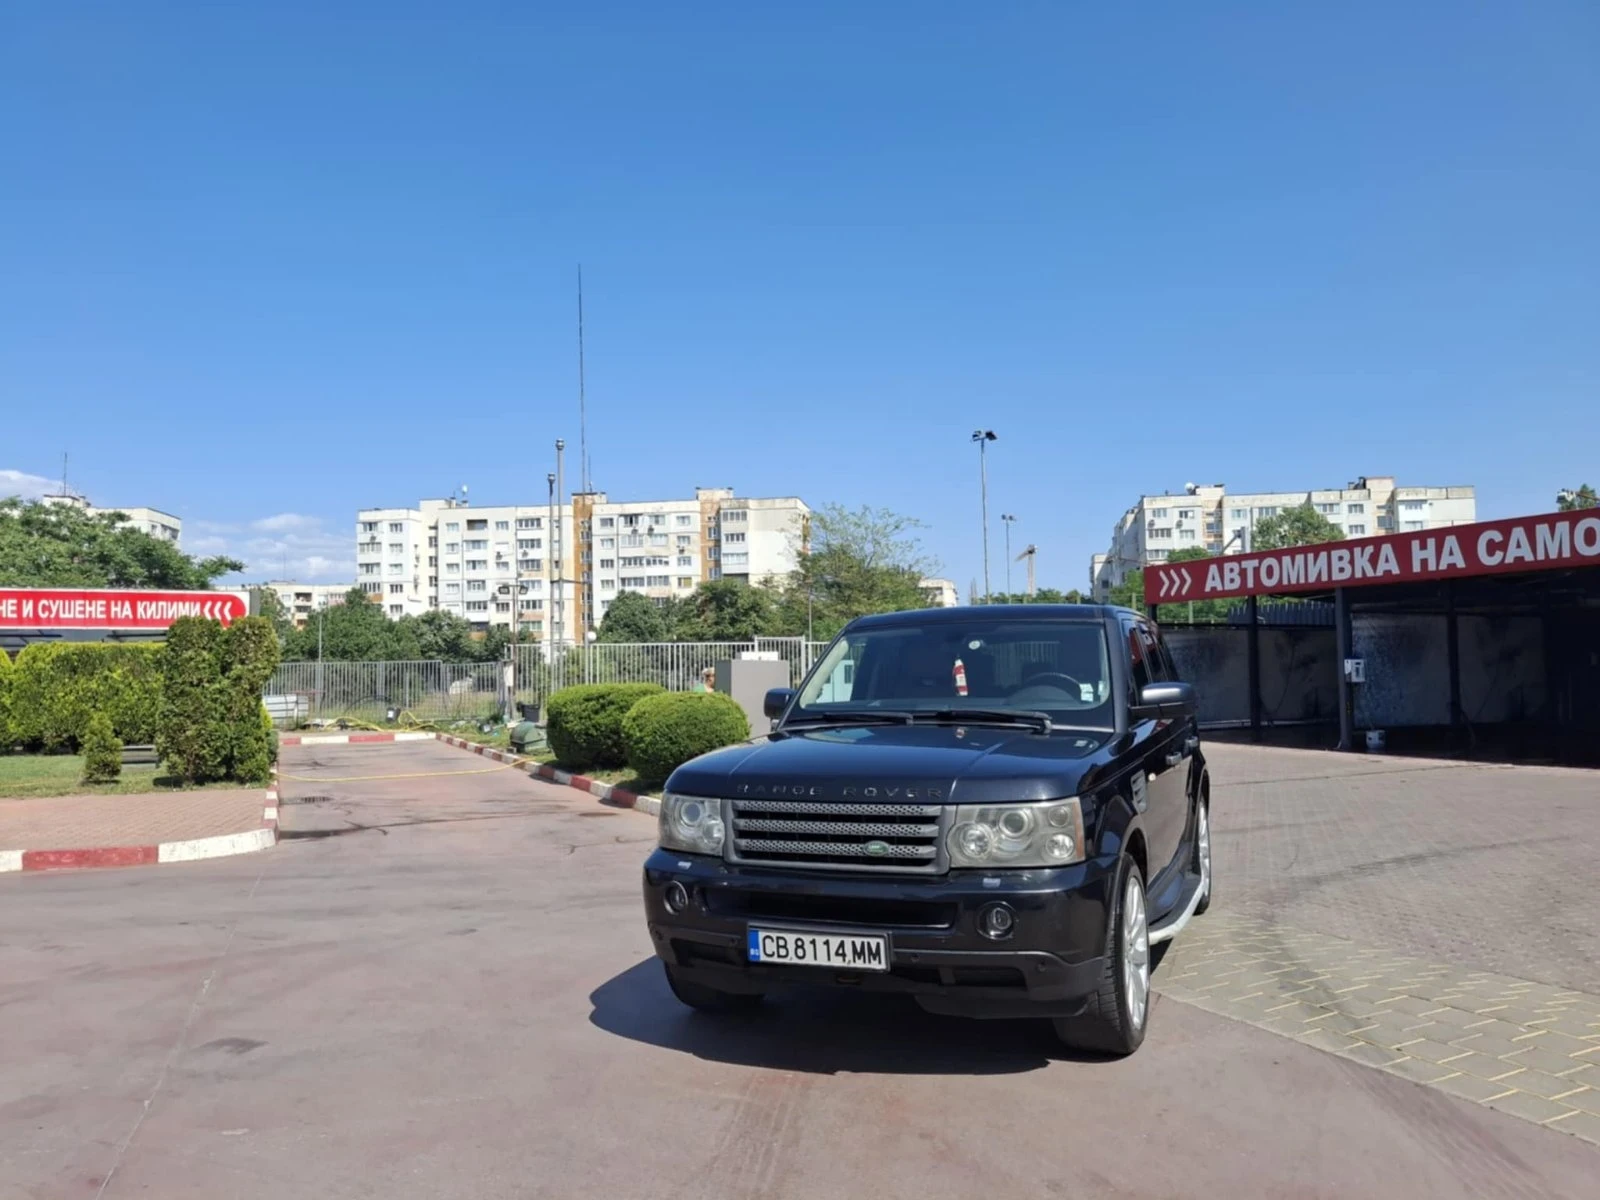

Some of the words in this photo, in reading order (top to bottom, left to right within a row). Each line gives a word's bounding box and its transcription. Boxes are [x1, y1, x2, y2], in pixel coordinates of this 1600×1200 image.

[1204, 543, 1400, 592] АВТОМИВКА
[1411, 535, 1466, 573] НА
[1477, 517, 1600, 566] САМО
[22, 599, 34, 618] И
[38, 599, 107, 619] СУШЕНЕ
[110, 600, 133, 619] НА
[136, 600, 201, 619] КИЛИМИ
[842, 786, 942, 798] ROVER
